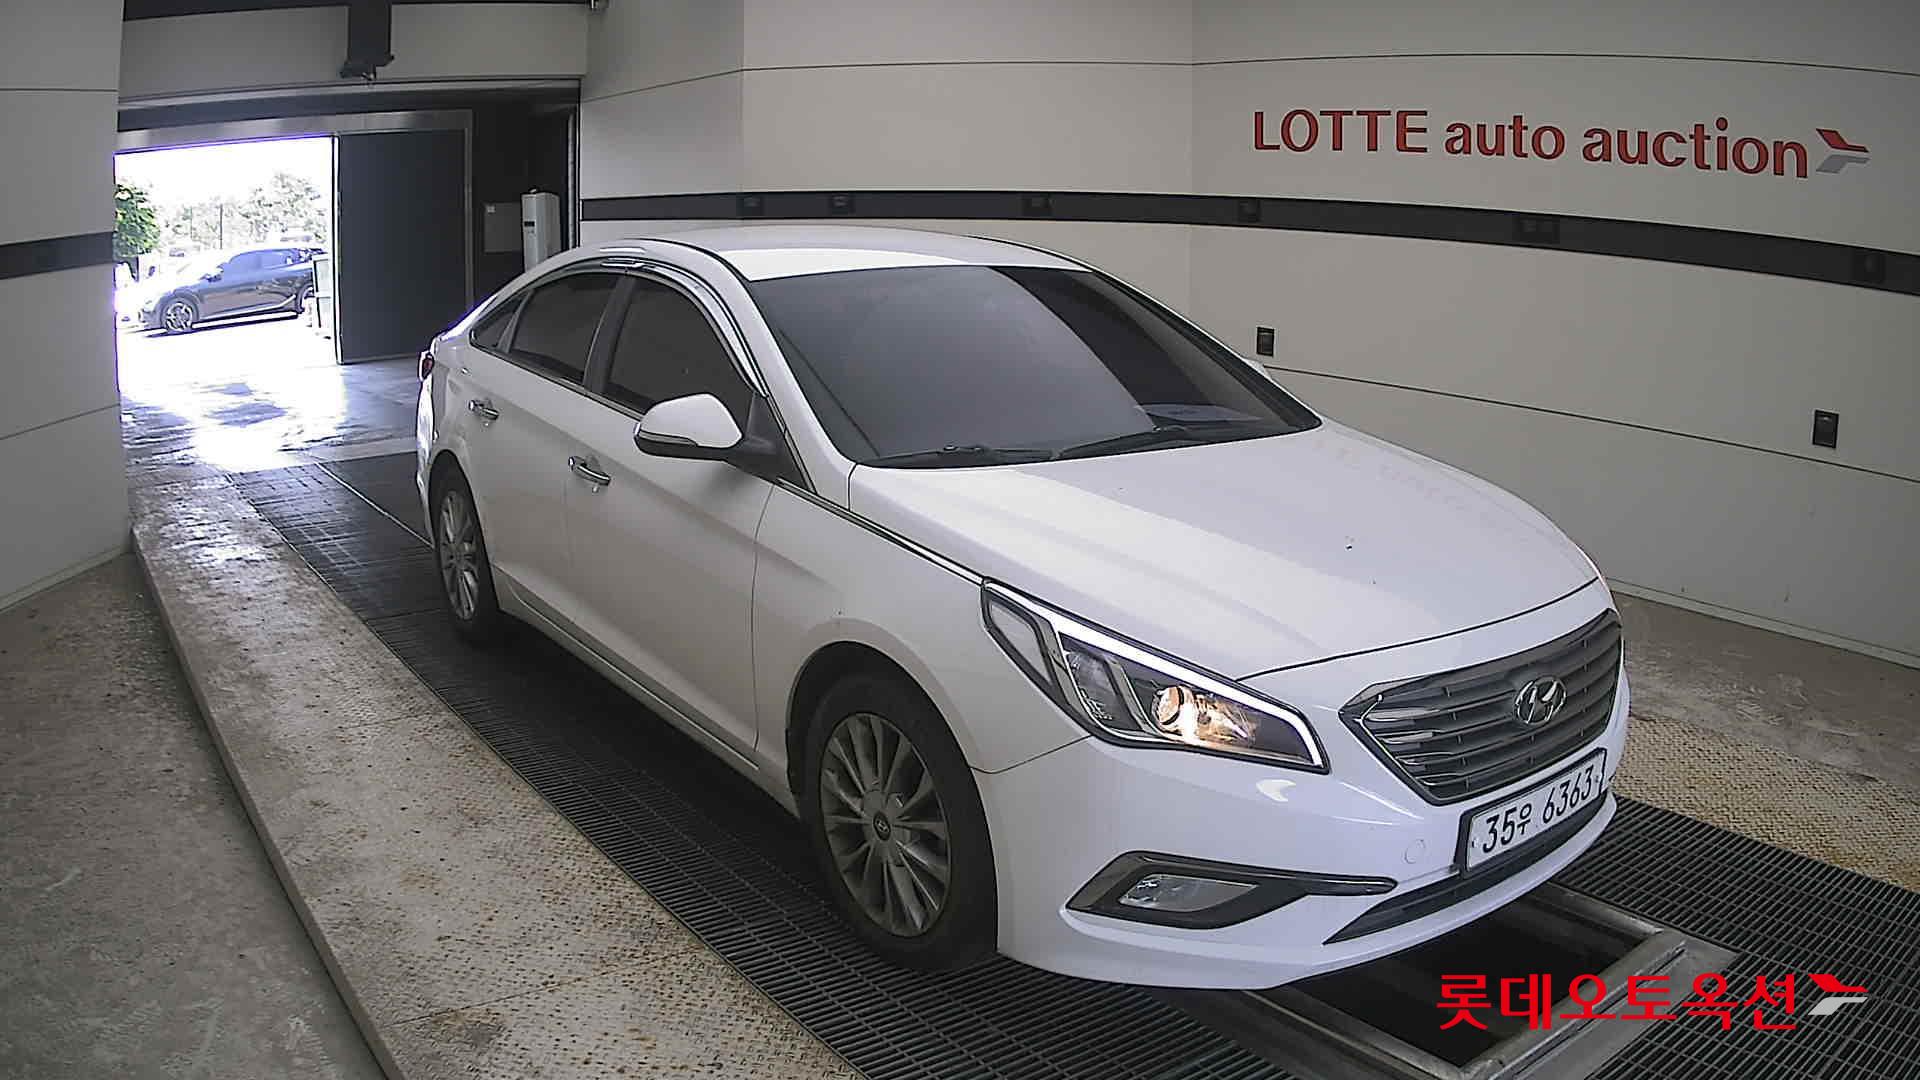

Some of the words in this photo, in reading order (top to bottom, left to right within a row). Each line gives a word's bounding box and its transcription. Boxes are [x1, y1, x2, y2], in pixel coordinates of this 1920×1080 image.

[1254, 109, 1428, 153] LOTTE
[1444, 114, 1567, 160] auto
[1582, 116, 1809, 179] auction
[1482, 803, 1532, 853] 35우
[1542, 764, 1595, 824] 6363
